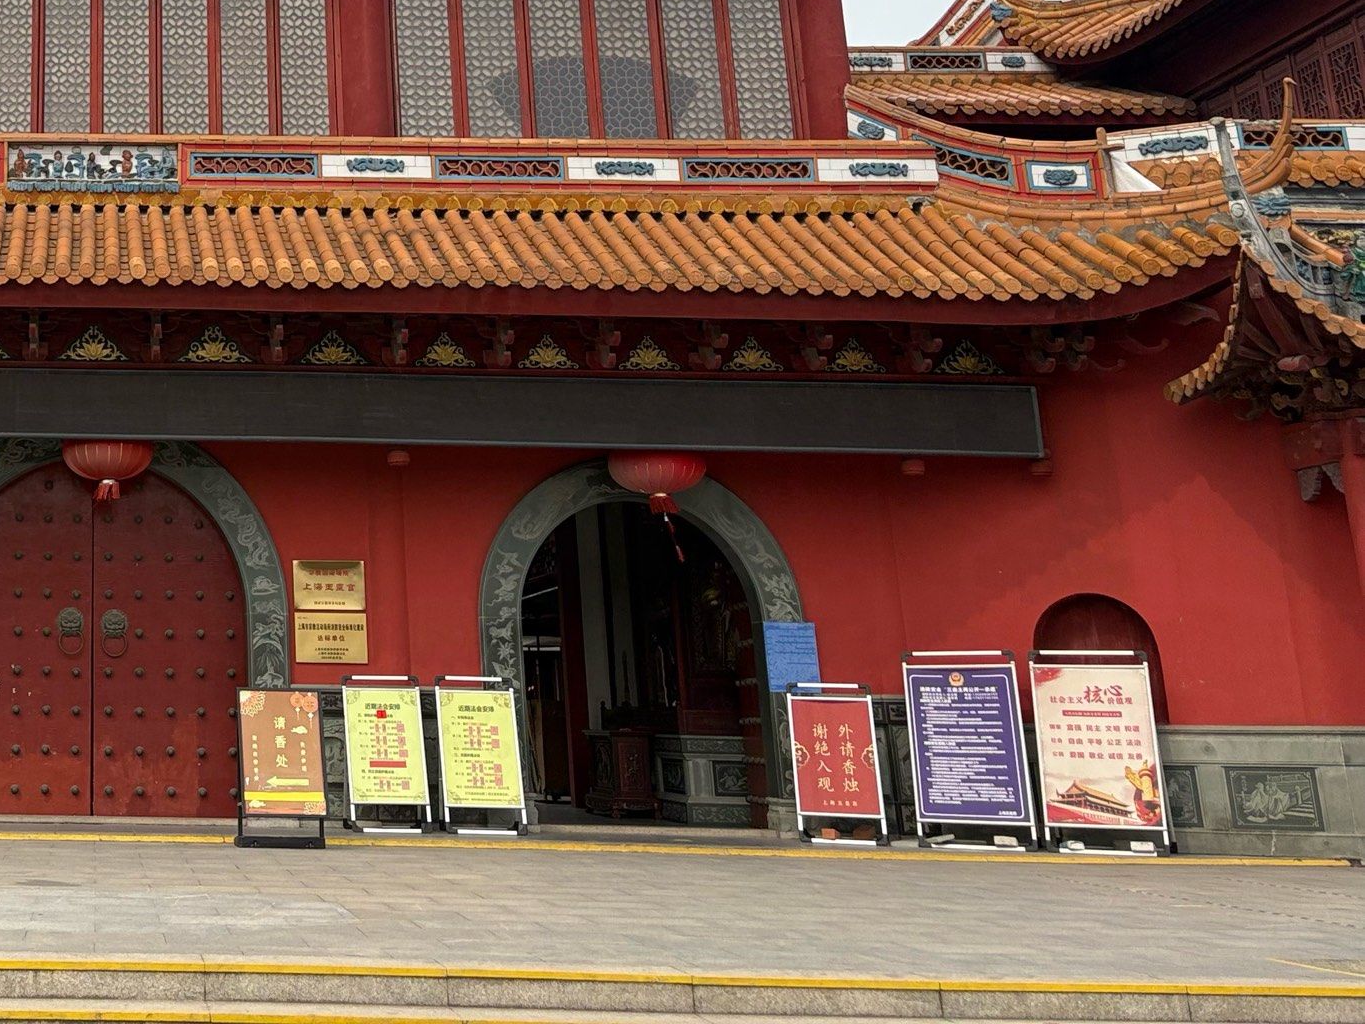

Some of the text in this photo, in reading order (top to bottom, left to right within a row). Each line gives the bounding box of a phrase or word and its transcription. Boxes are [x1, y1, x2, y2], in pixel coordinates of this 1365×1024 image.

[1049, 684, 1134, 706] 社会主义核心价值观
[273, 716, 289, 768] 请香处
[1086, 724, 1102, 732] 民主
[1105, 724, 1121, 732] 文明
[1087, 738, 1103, 746] 平等
[1107, 738, 1123, 746] 公正
[812, 723, 835, 793] 谢绝入观
[838, 723, 860, 793] 外请香烛
